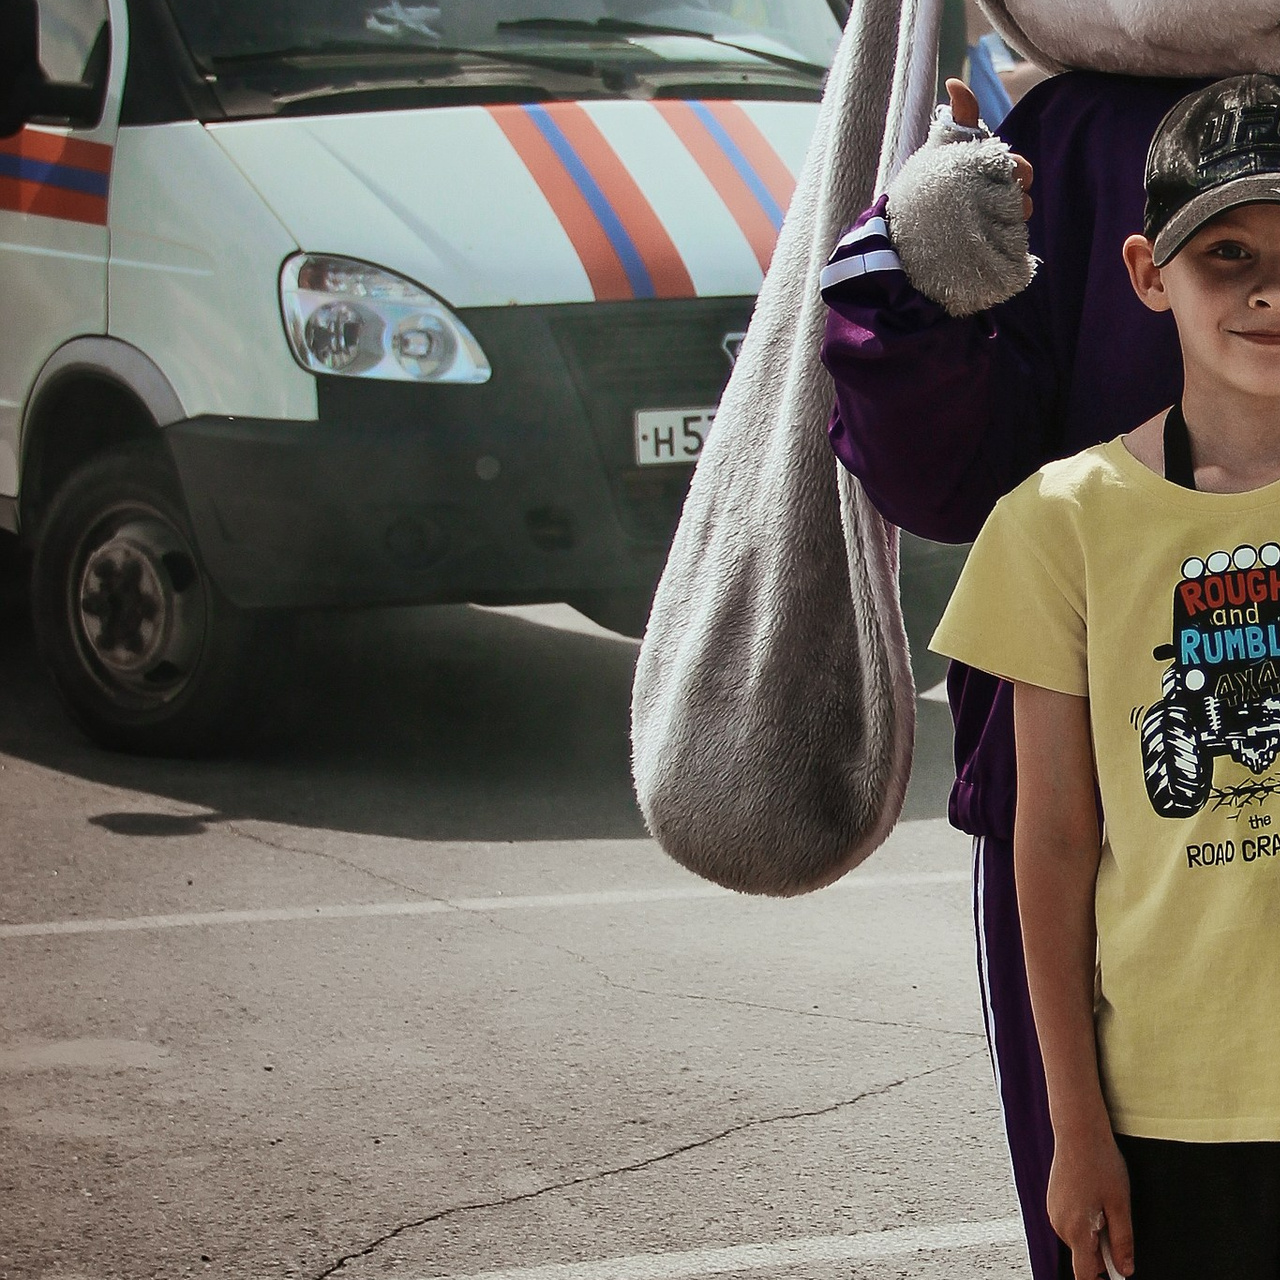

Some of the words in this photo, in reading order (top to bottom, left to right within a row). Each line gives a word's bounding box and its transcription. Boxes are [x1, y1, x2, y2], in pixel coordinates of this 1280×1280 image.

[1213, 602, 1260, 626] and
[1249, 813, 1272, 830] the
[1186, 840, 1235, 868] ROAD
